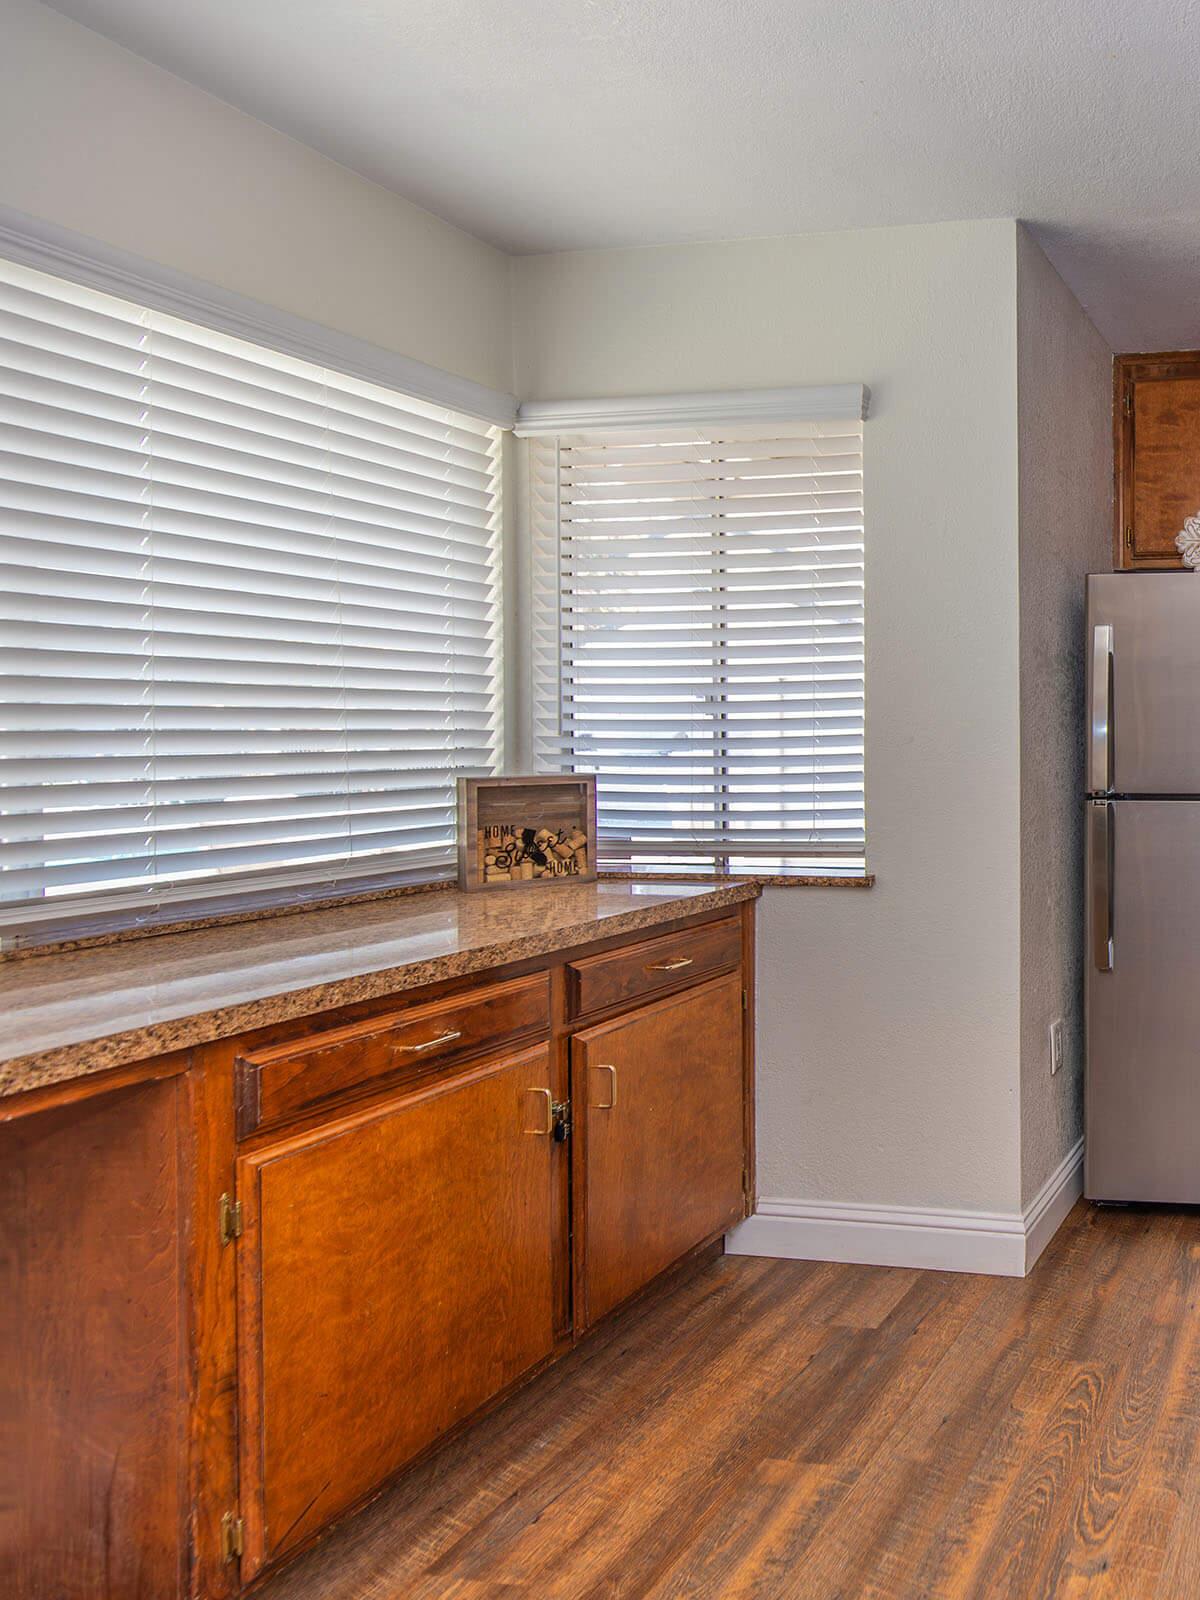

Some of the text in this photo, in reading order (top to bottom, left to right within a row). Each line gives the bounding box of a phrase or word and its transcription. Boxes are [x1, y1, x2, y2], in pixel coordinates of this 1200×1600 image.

[484, 825, 516, 839] HOME
[494, 828, 568, 869] Sweet
[549, 860, 579, 876] HOME
